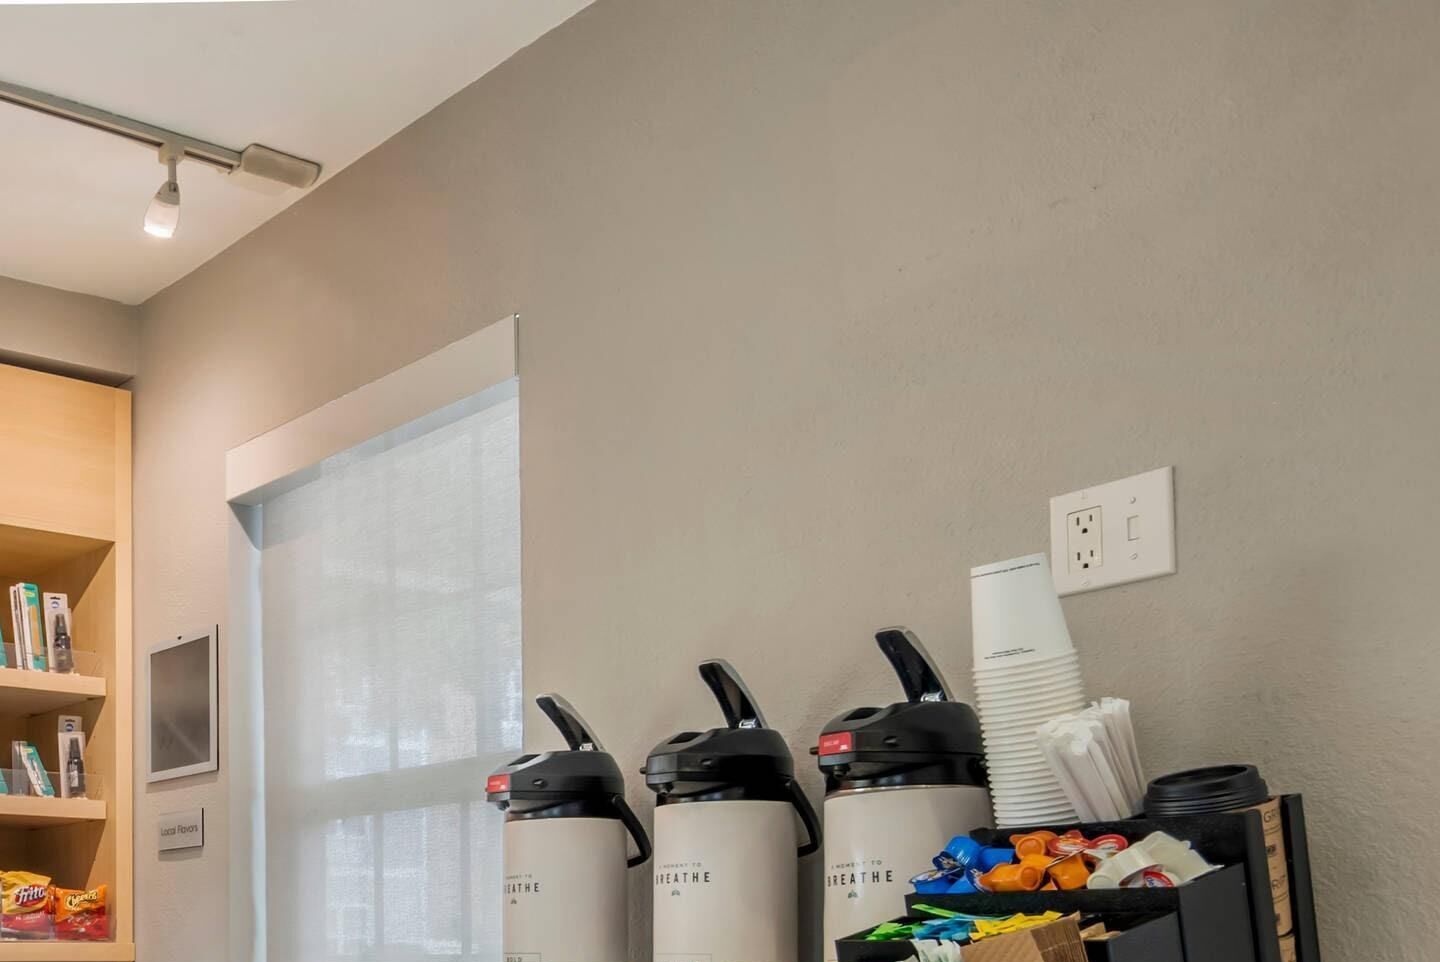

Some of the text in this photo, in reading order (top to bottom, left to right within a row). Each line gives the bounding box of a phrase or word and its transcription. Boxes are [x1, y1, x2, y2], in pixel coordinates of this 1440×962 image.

[161, 827, 177, 837] Local
[827, 870, 893, 887] BREATHE
[15, 887, 46, 905] Frito
